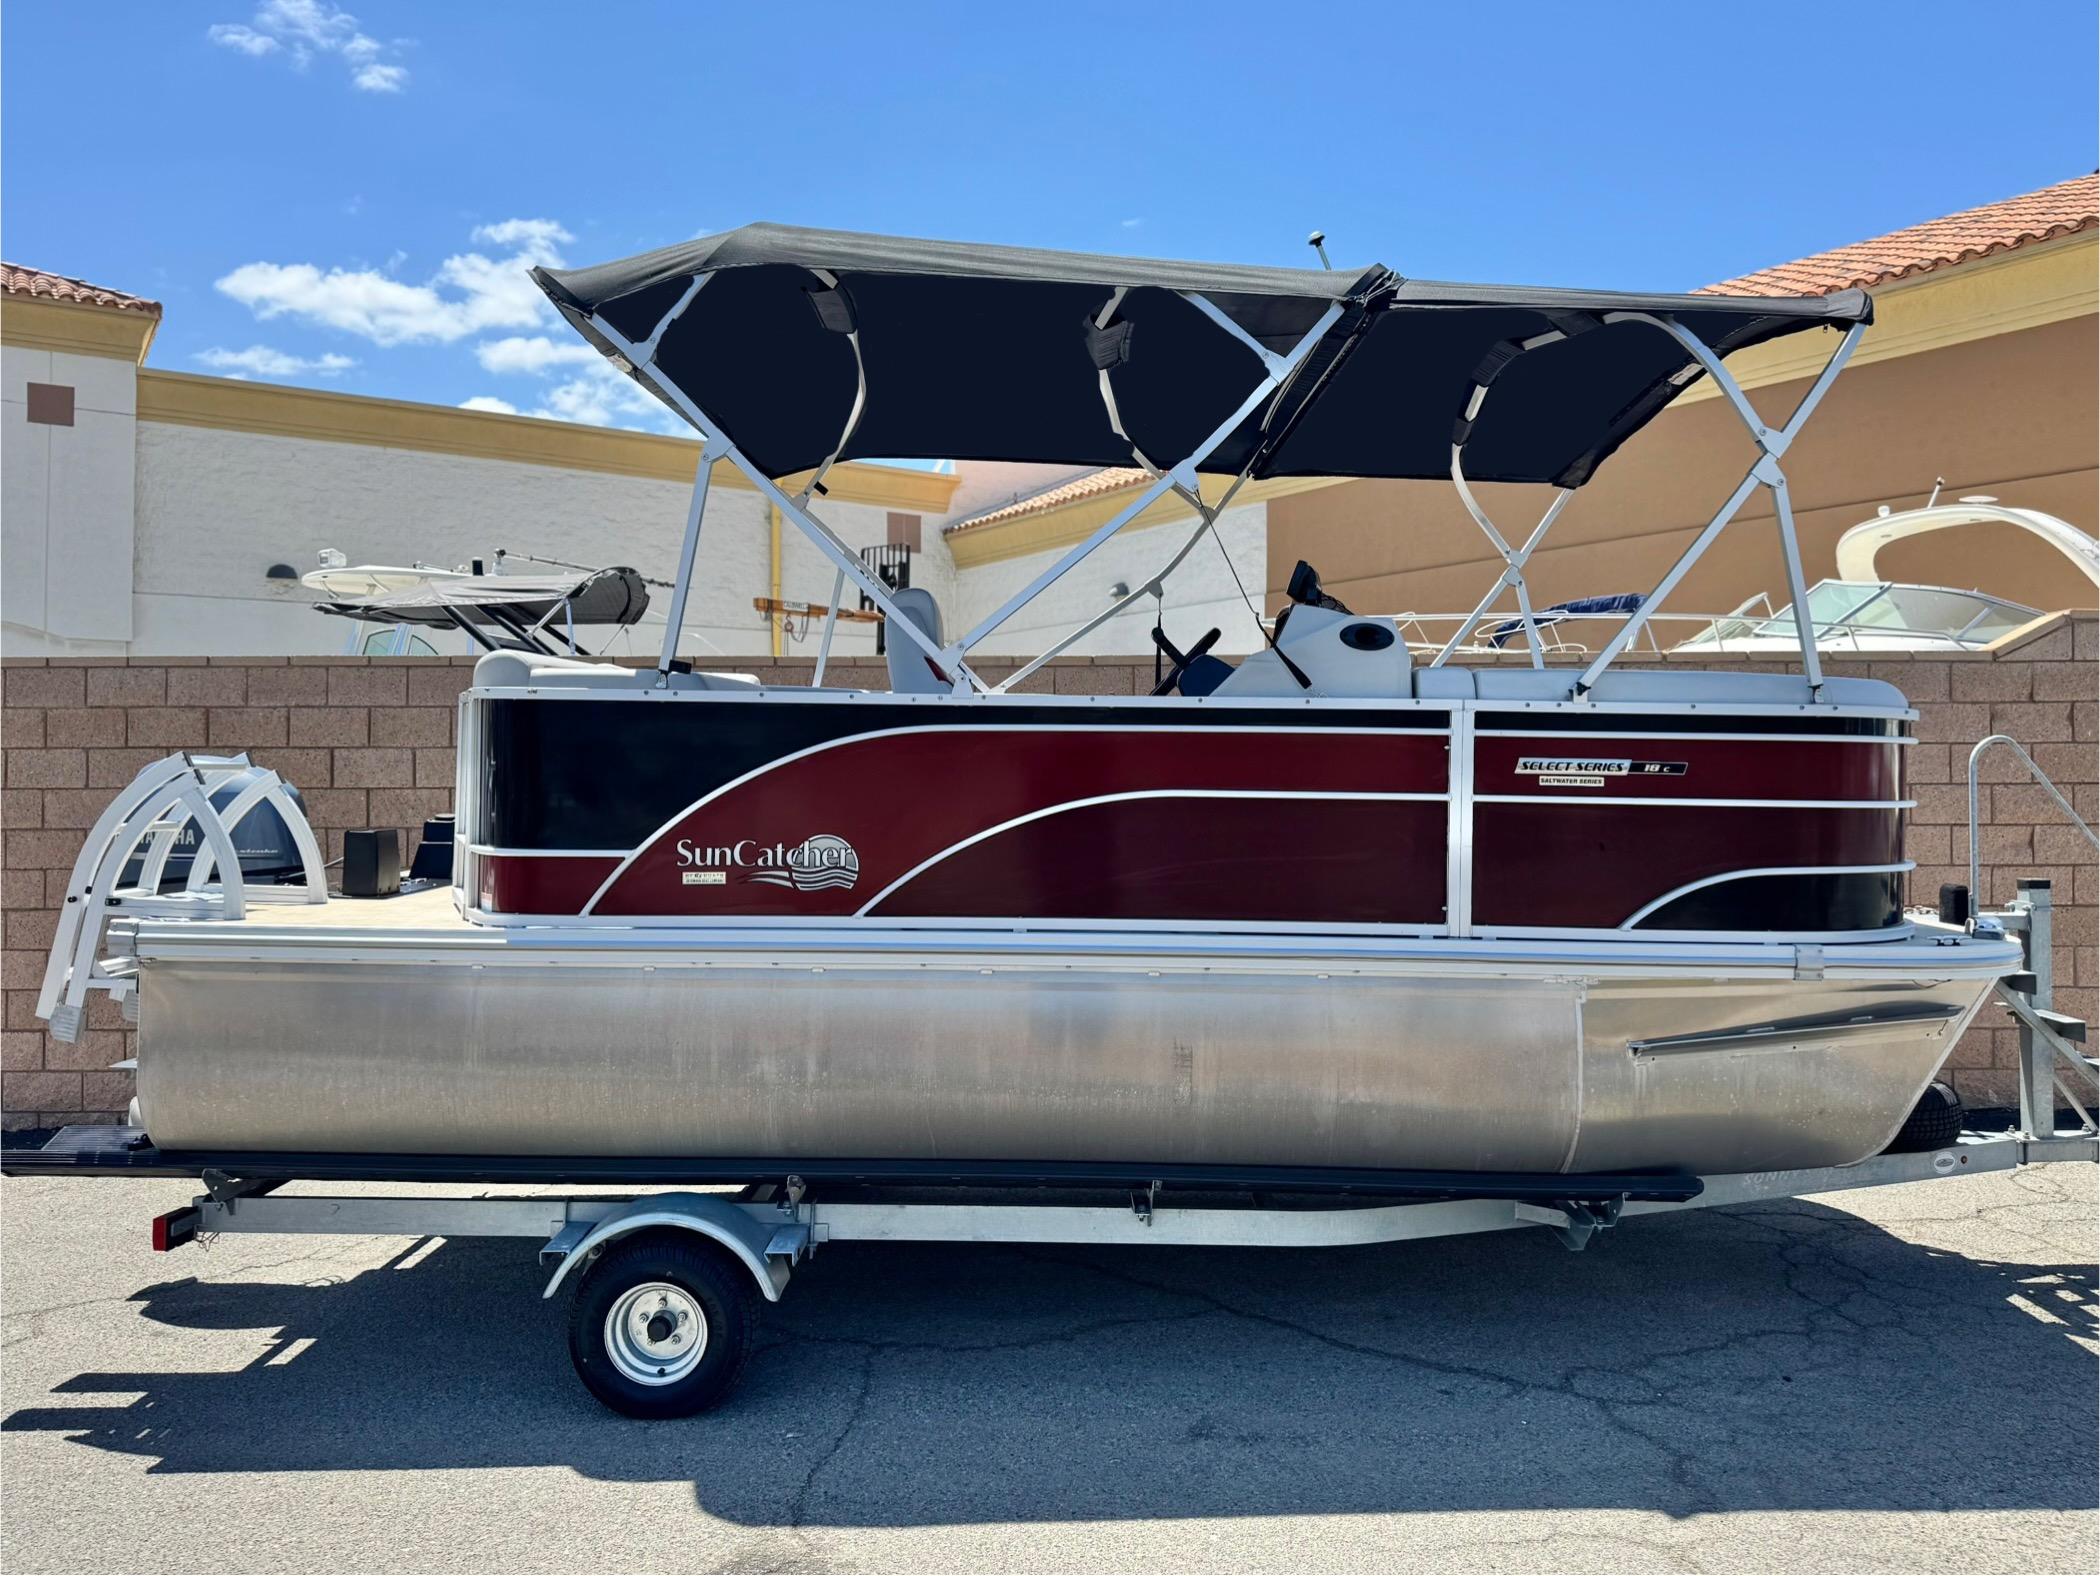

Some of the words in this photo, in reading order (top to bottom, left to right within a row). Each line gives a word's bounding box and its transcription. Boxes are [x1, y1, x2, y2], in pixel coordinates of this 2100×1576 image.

[1520, 761, 1573, 771] SELECT
[1575, 762, 1625, 772] SERIES
[1644, 763, 1661, 772] 18
[1540, 777, 1578, 785] SALTWATER
[676, 839, 852, 867] SunCatcher
